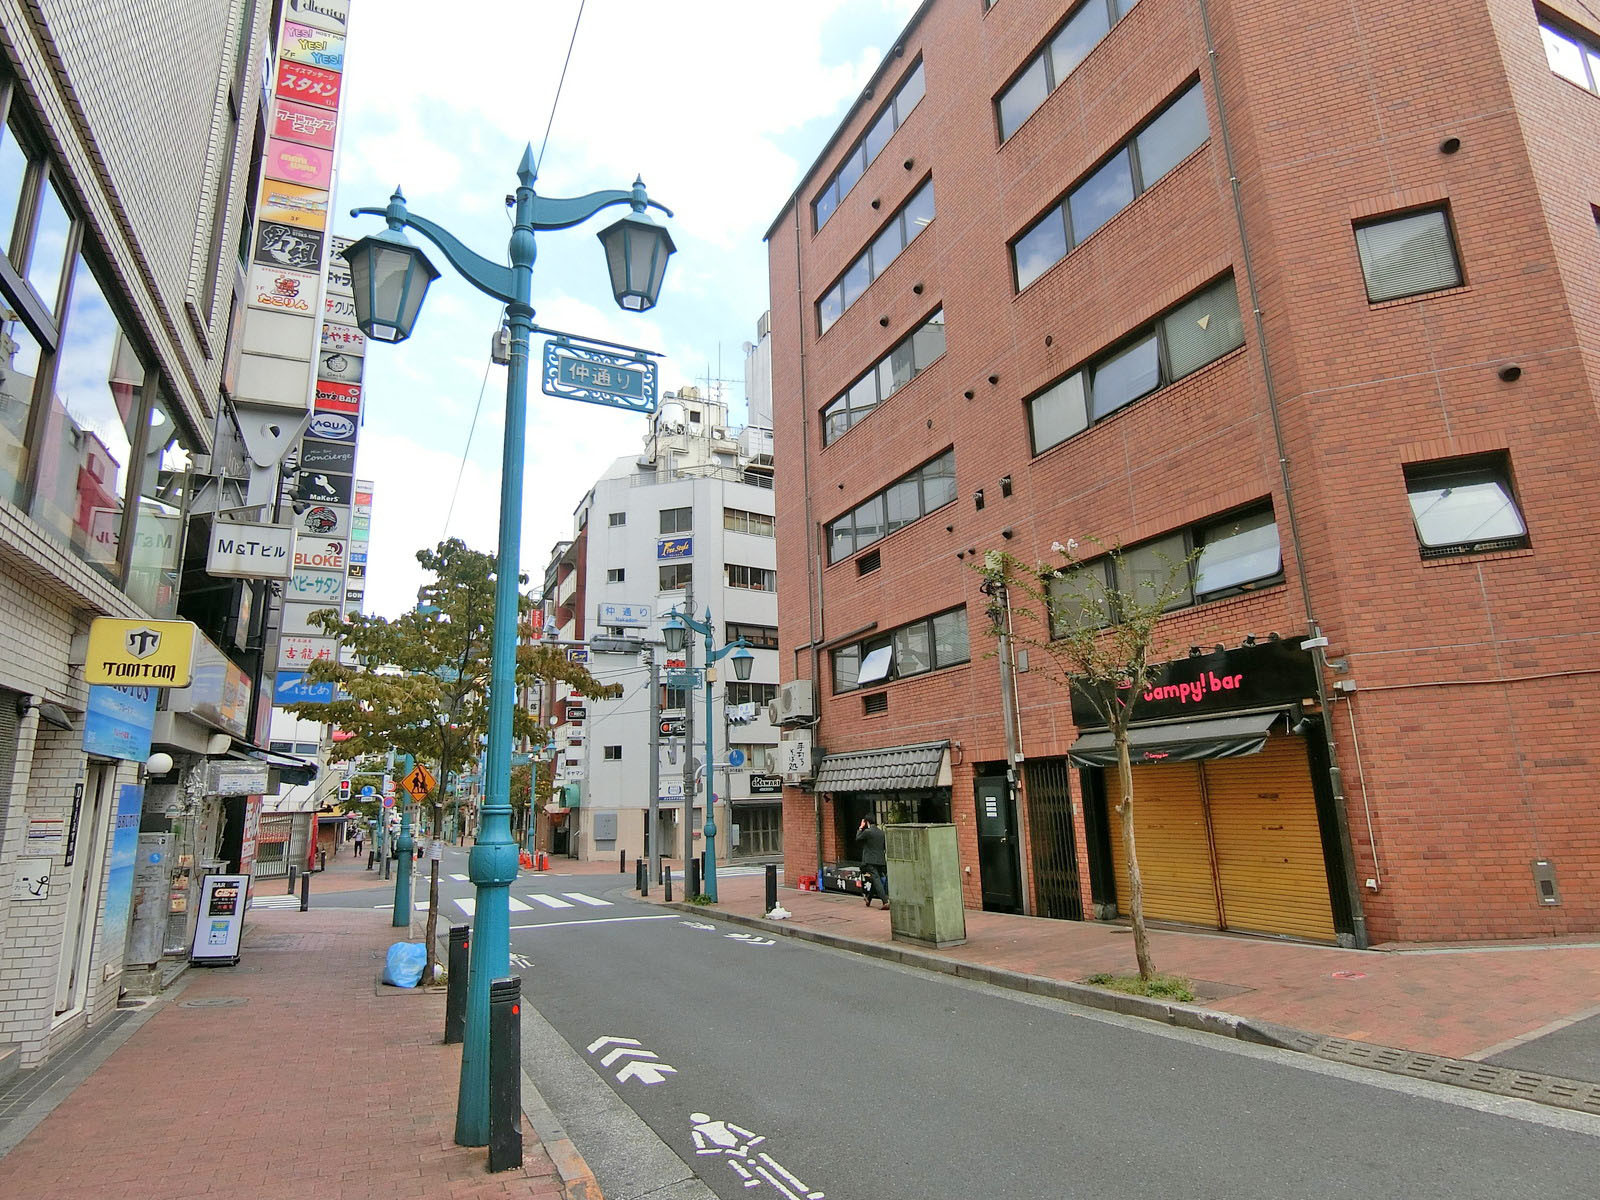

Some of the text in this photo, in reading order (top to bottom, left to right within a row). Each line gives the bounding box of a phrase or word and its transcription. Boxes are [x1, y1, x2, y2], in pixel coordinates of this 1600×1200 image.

[288, 27, 313, 38] YES!
[298, 39, 327, 51] YES!
[283, 49, 296, 57] 7F
[311, 52, 343, 65] YES!
[281, 74, 338, 97] スタメン
[329, 332, 363, 345] やまだ
[569, 362, 631, 390] 仲通り
[338, 394, 358, 404] BAR
[313, 420, 348, 431] AQUA
[304, 452, 352, 463] Concierge
[217, 538, 286, 558] M&Tビル
[294, 552, 343, 568] BLOKE
[289, 575, 341, 594] ベビーサタン
[605, 606, 648, 617] 仲通り
[1208, 670, 1244, 692] bar
[295, 684, 330, 697] はじめ
